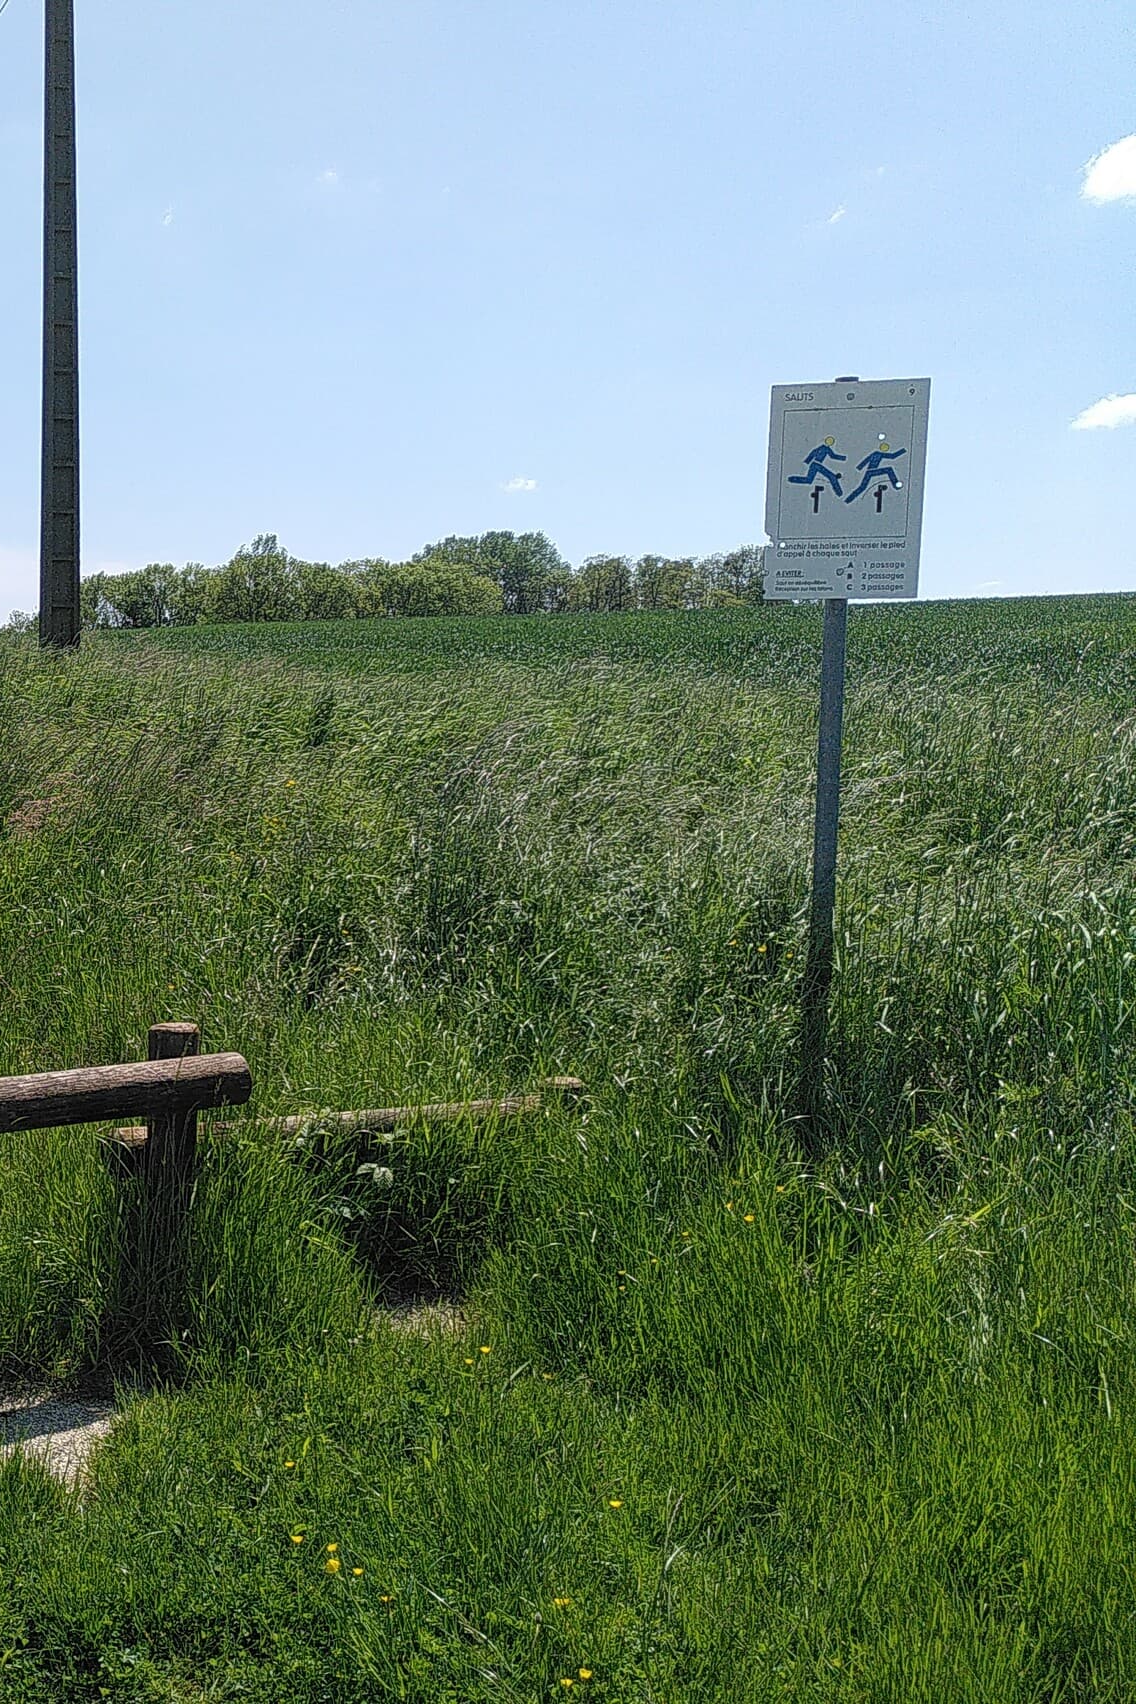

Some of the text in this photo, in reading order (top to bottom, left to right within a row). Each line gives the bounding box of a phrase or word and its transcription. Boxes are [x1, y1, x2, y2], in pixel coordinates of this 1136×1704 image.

[909, 388, 915, 396] 9
[784, 392, 814, 402] SAUTS
[888, 540, 906, 549] pied
[812, 550, 840, 558] chaque
[867, 584, 904, 592] passages
